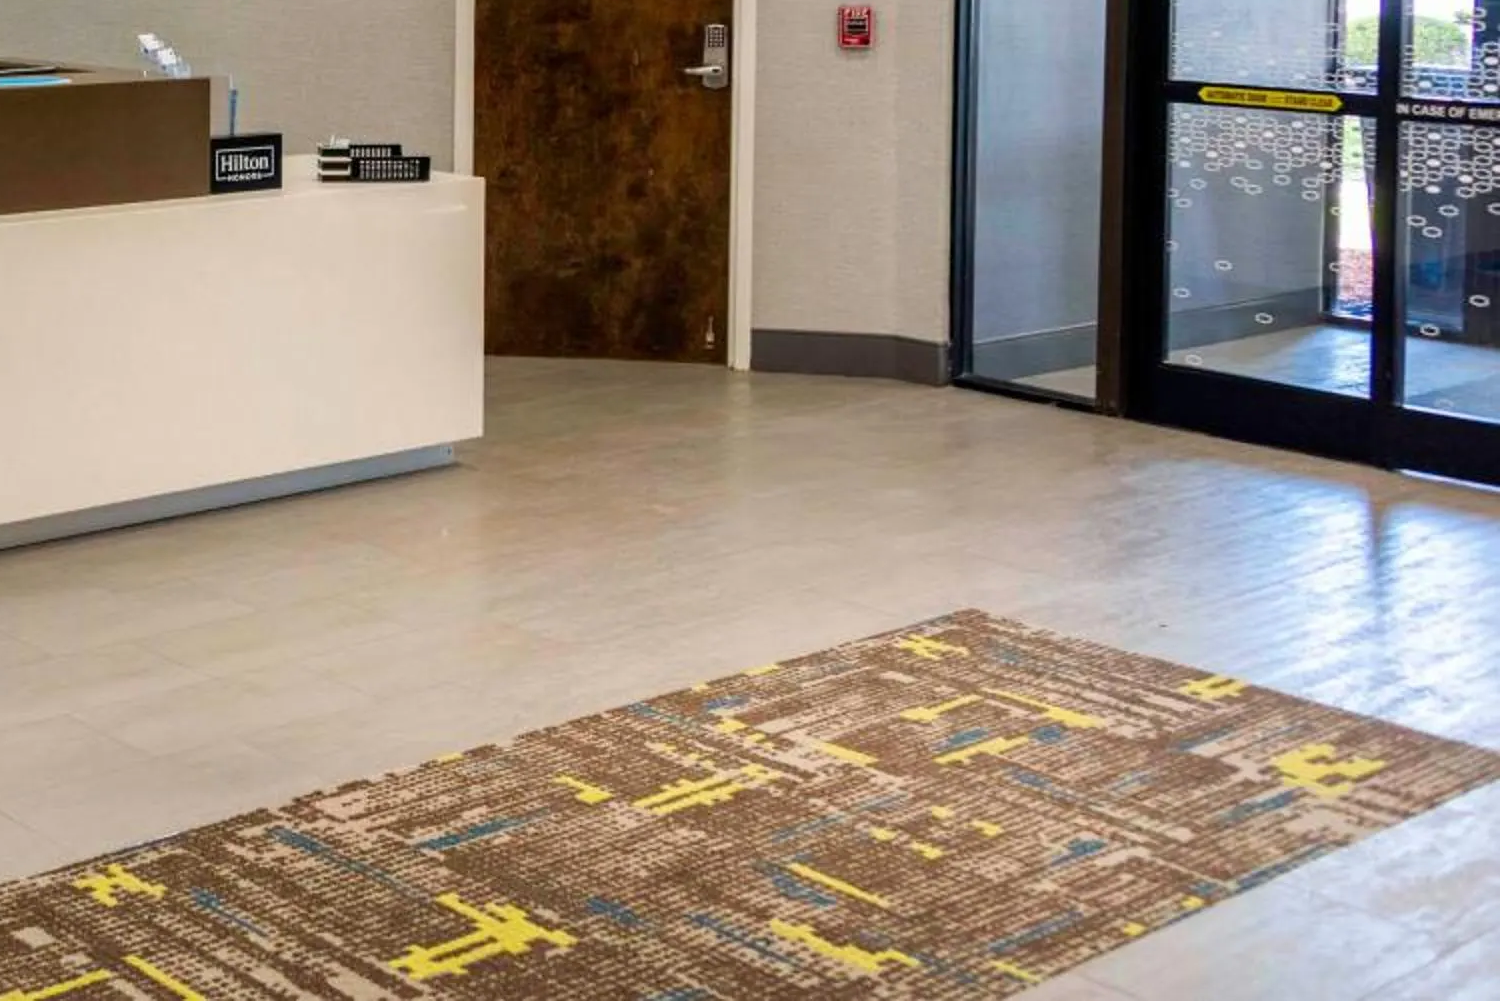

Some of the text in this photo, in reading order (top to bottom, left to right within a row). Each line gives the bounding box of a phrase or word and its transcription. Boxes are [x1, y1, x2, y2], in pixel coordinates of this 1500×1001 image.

[1396, 103, 1409, 115] IN
[1412, 104, 1446, 117] CASE
[1448, 106, 1467, 118] OF
[221, 153, 269, 172] Hilton
